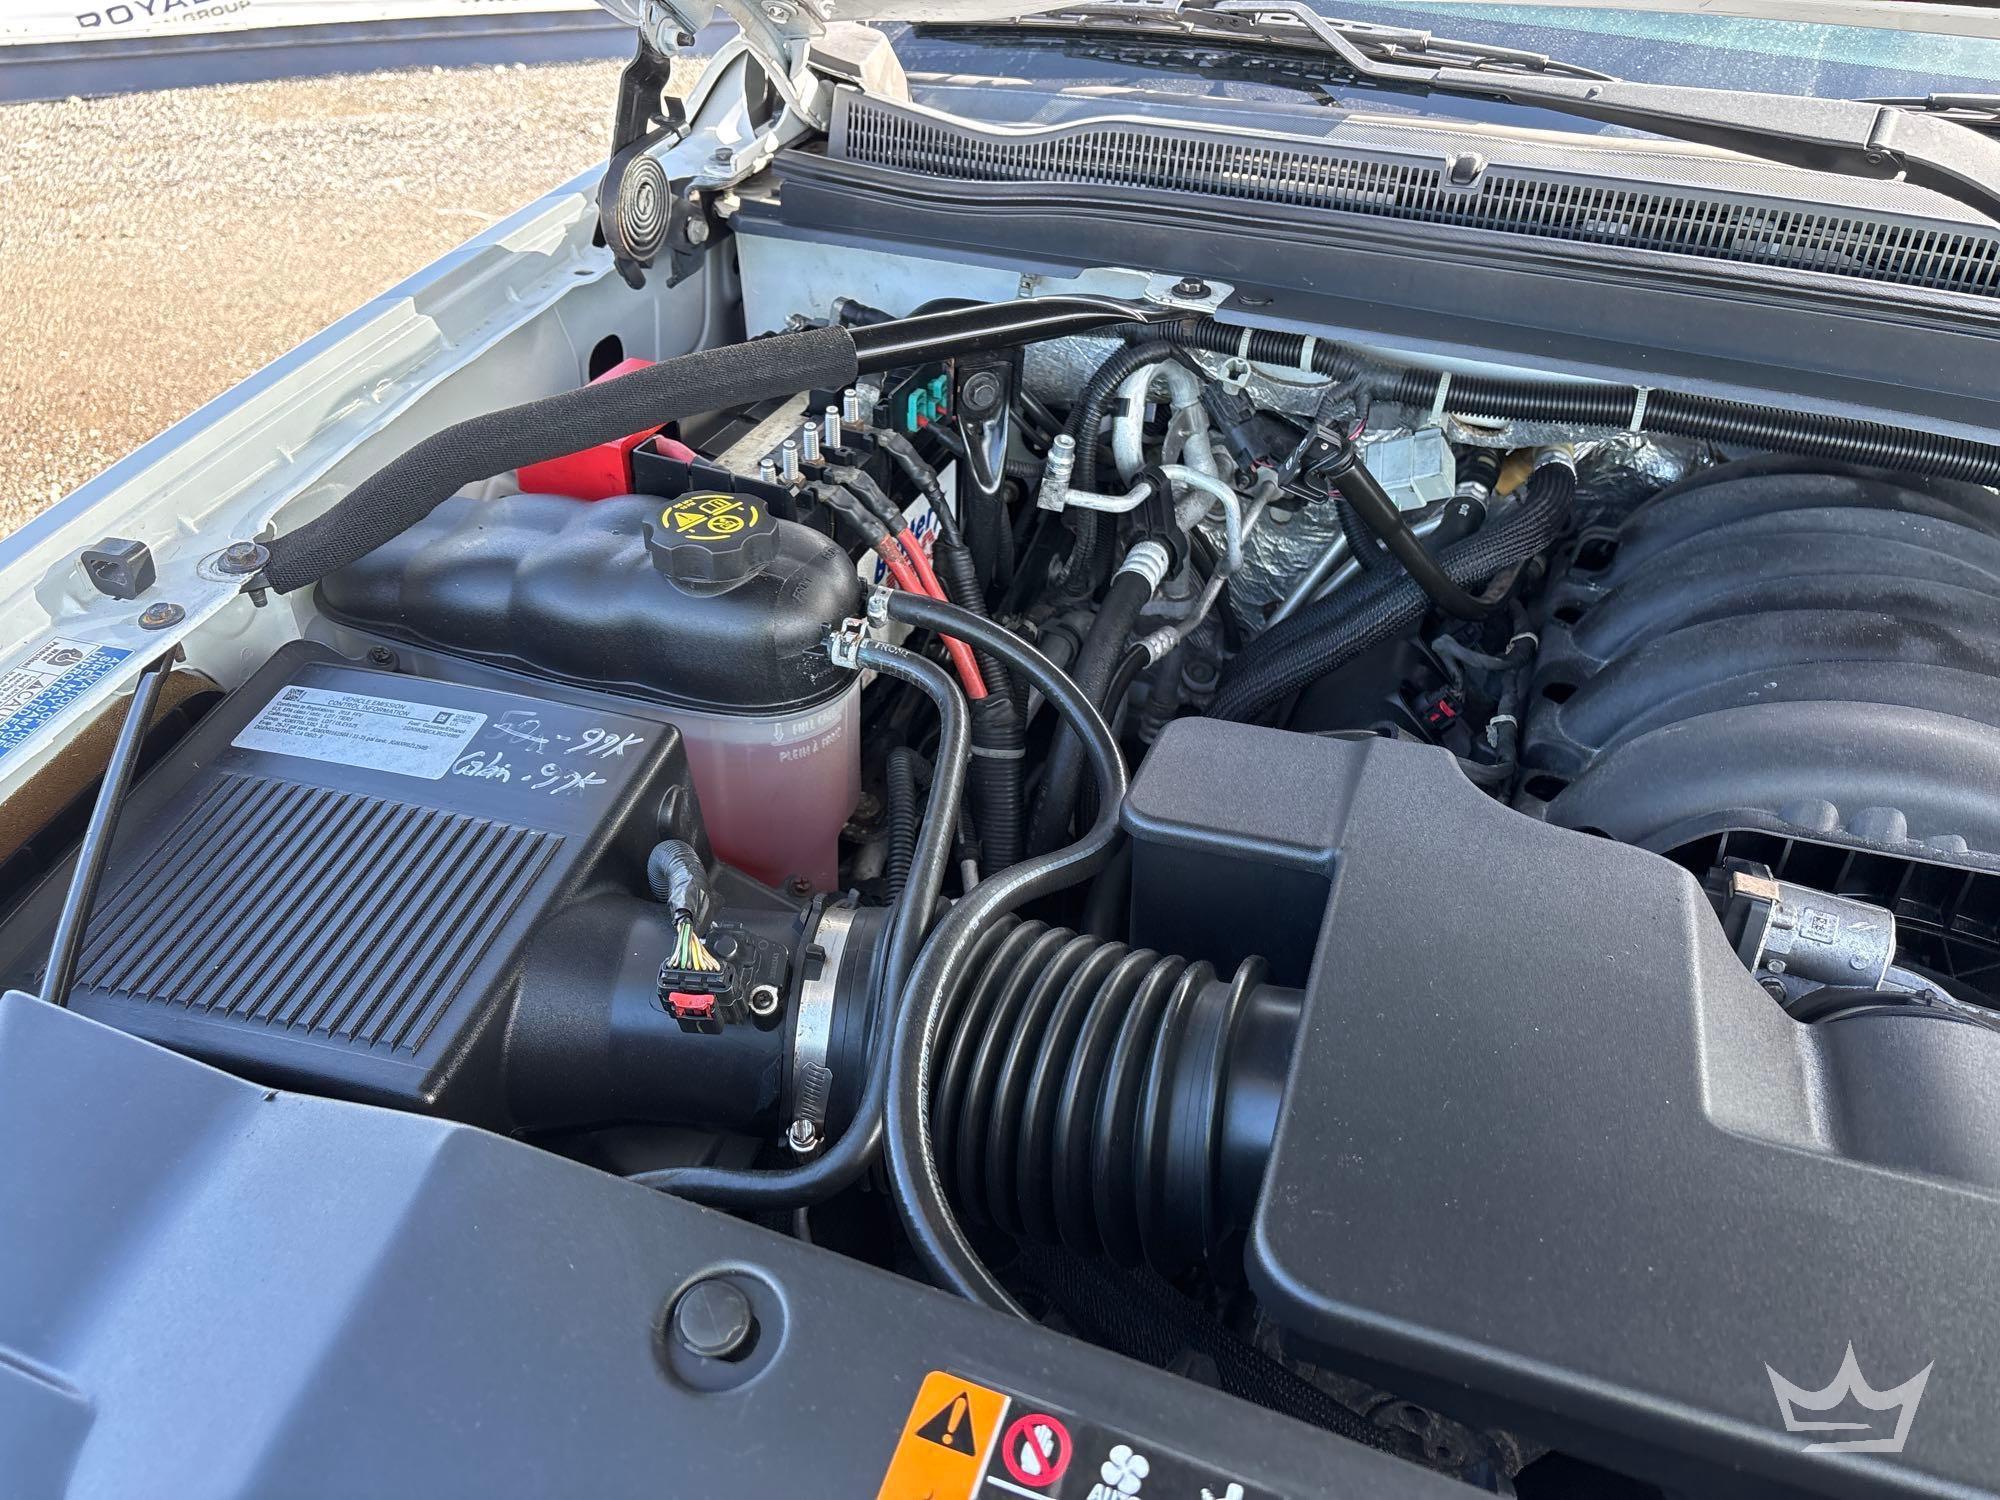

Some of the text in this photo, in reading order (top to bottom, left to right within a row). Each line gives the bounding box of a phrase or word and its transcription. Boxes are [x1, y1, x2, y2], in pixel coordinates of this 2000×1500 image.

[74, 655, 110, 684] SIREN
[17, 652, 106, 716] UNPROTECTED
[48, 683, 72, 703] MAY
[5, 657, 120, 748] ACTIVATION OF THIS
[327, 699, 410, 716] CONTROL INFORMATION
[341, 696, 406, 709] VEHICLE EMISSION
